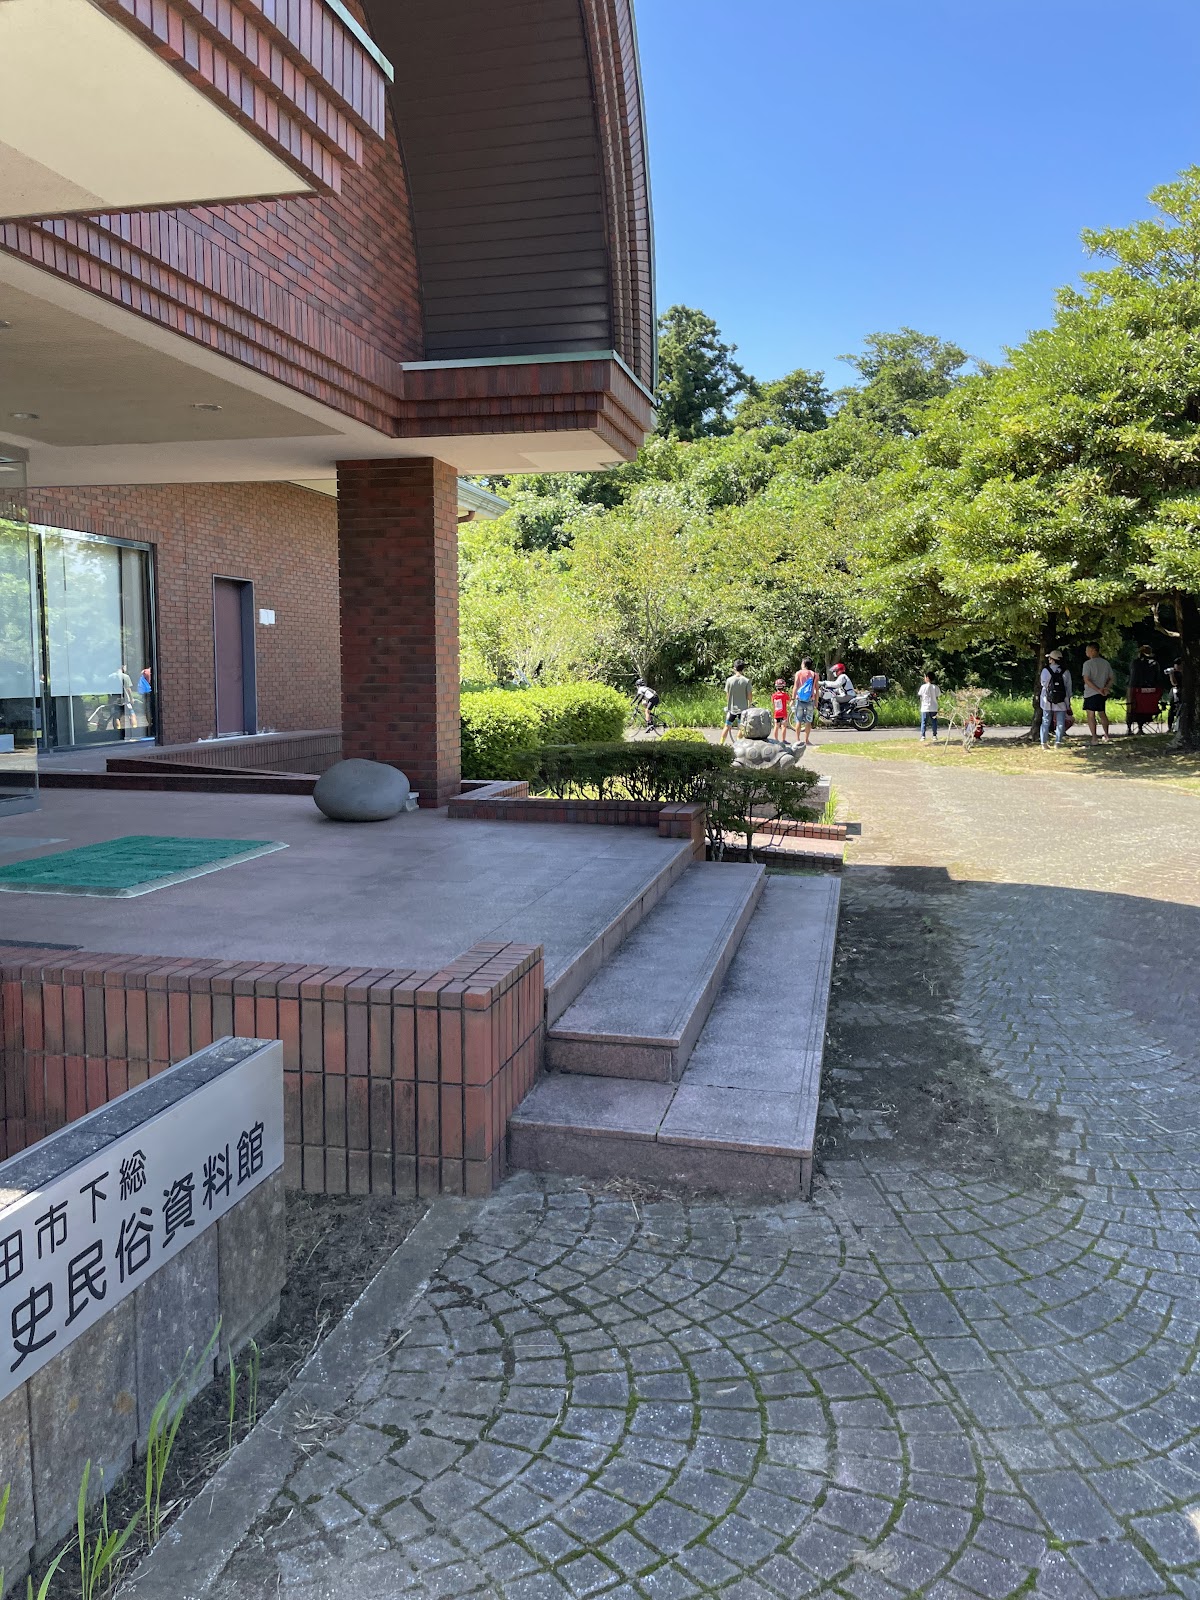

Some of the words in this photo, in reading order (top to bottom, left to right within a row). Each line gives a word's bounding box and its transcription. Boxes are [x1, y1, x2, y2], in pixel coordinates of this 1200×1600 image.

[10, 1121, 264, 1373] 史民俗資料館
